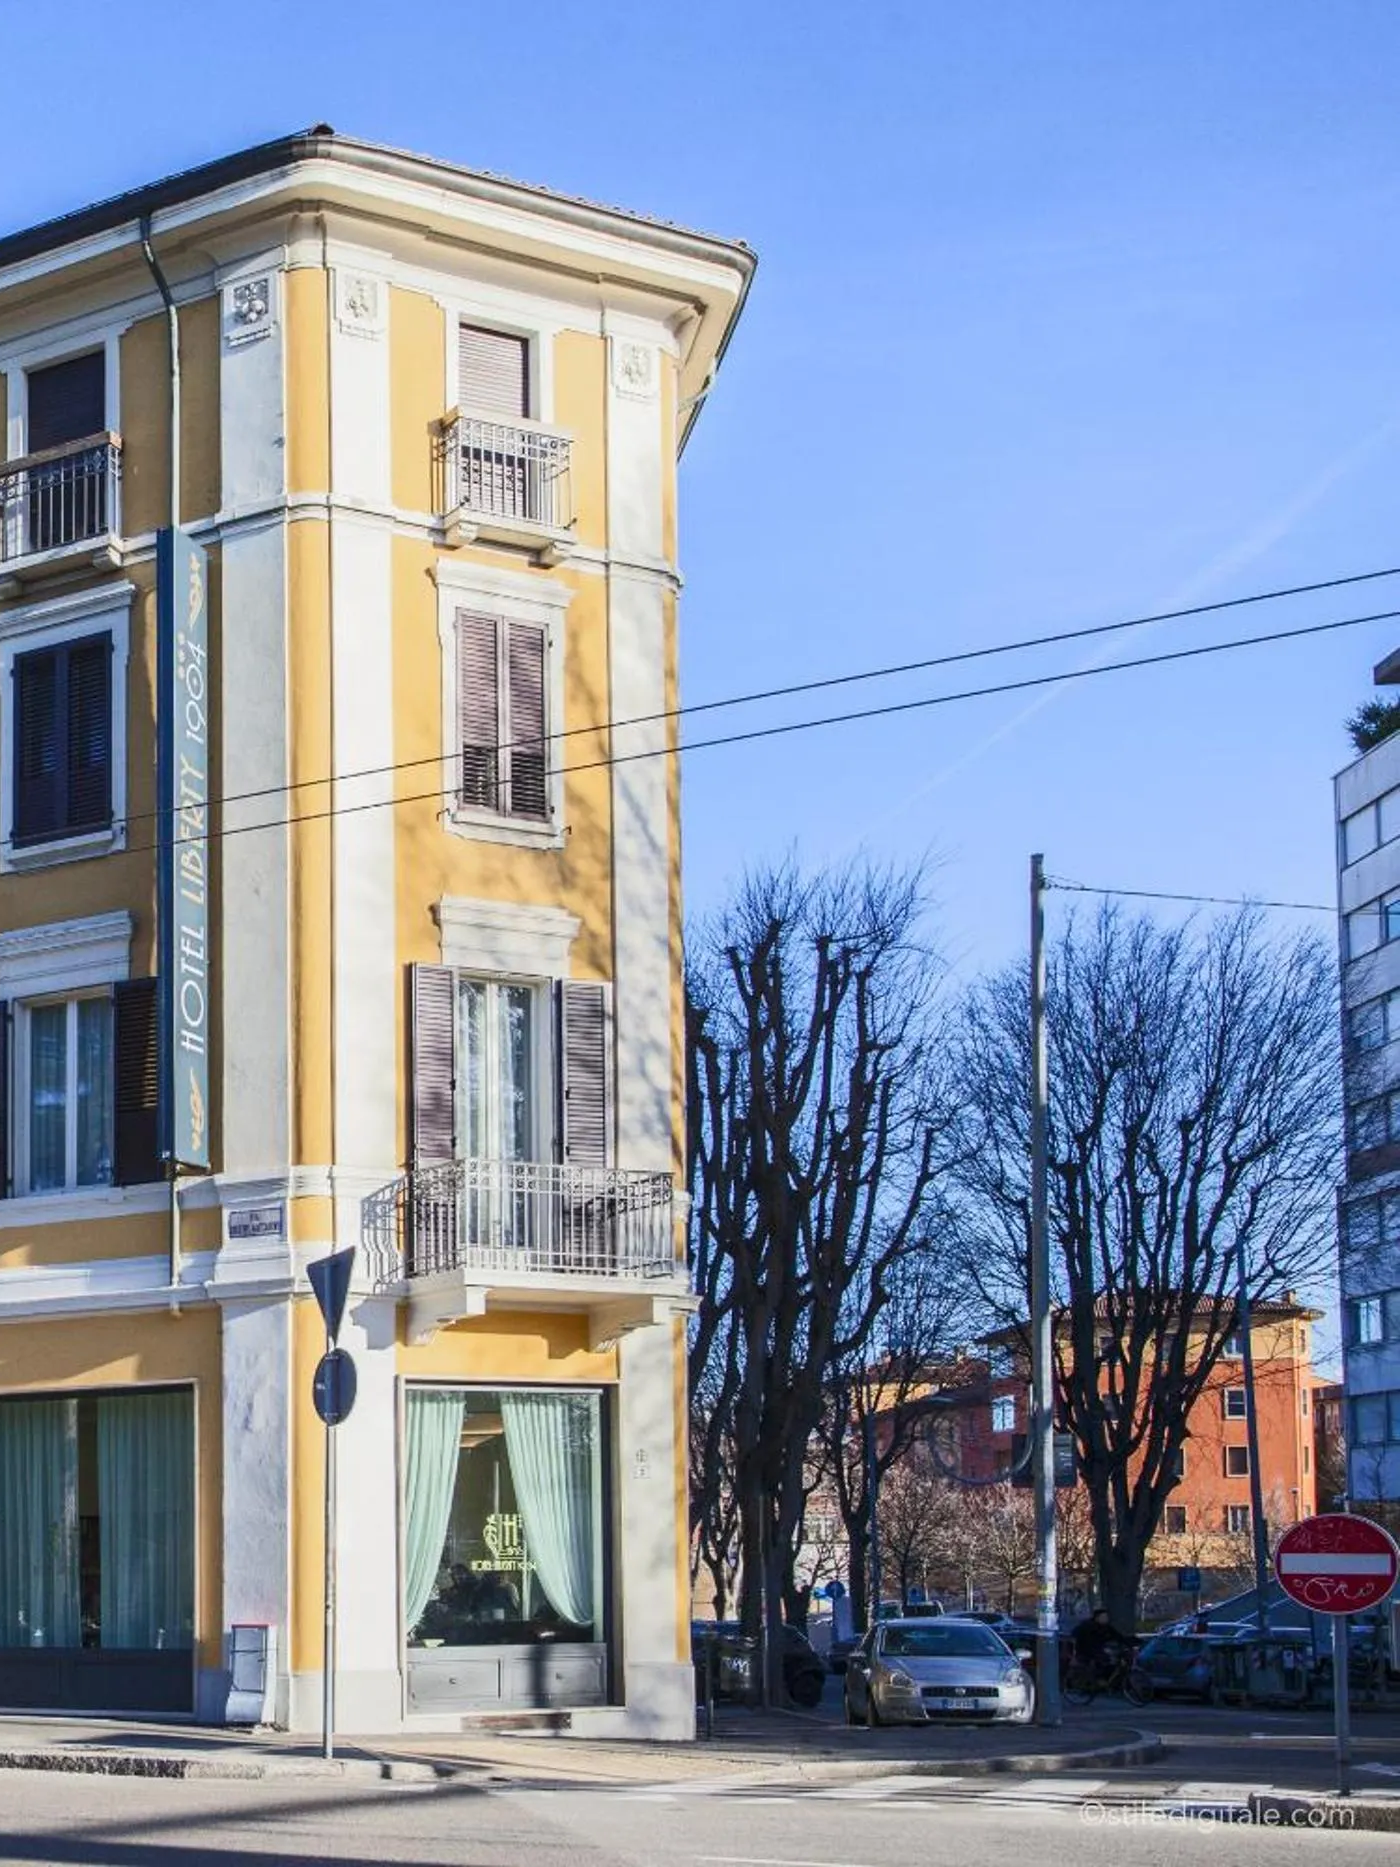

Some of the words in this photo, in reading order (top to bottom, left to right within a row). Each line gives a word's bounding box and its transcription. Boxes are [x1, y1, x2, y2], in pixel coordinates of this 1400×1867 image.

[184, 640, 206, 744] 1904
[180, 752, 204, 905] LIBERTY
[180, 924, 205, 1055] HOTEL
